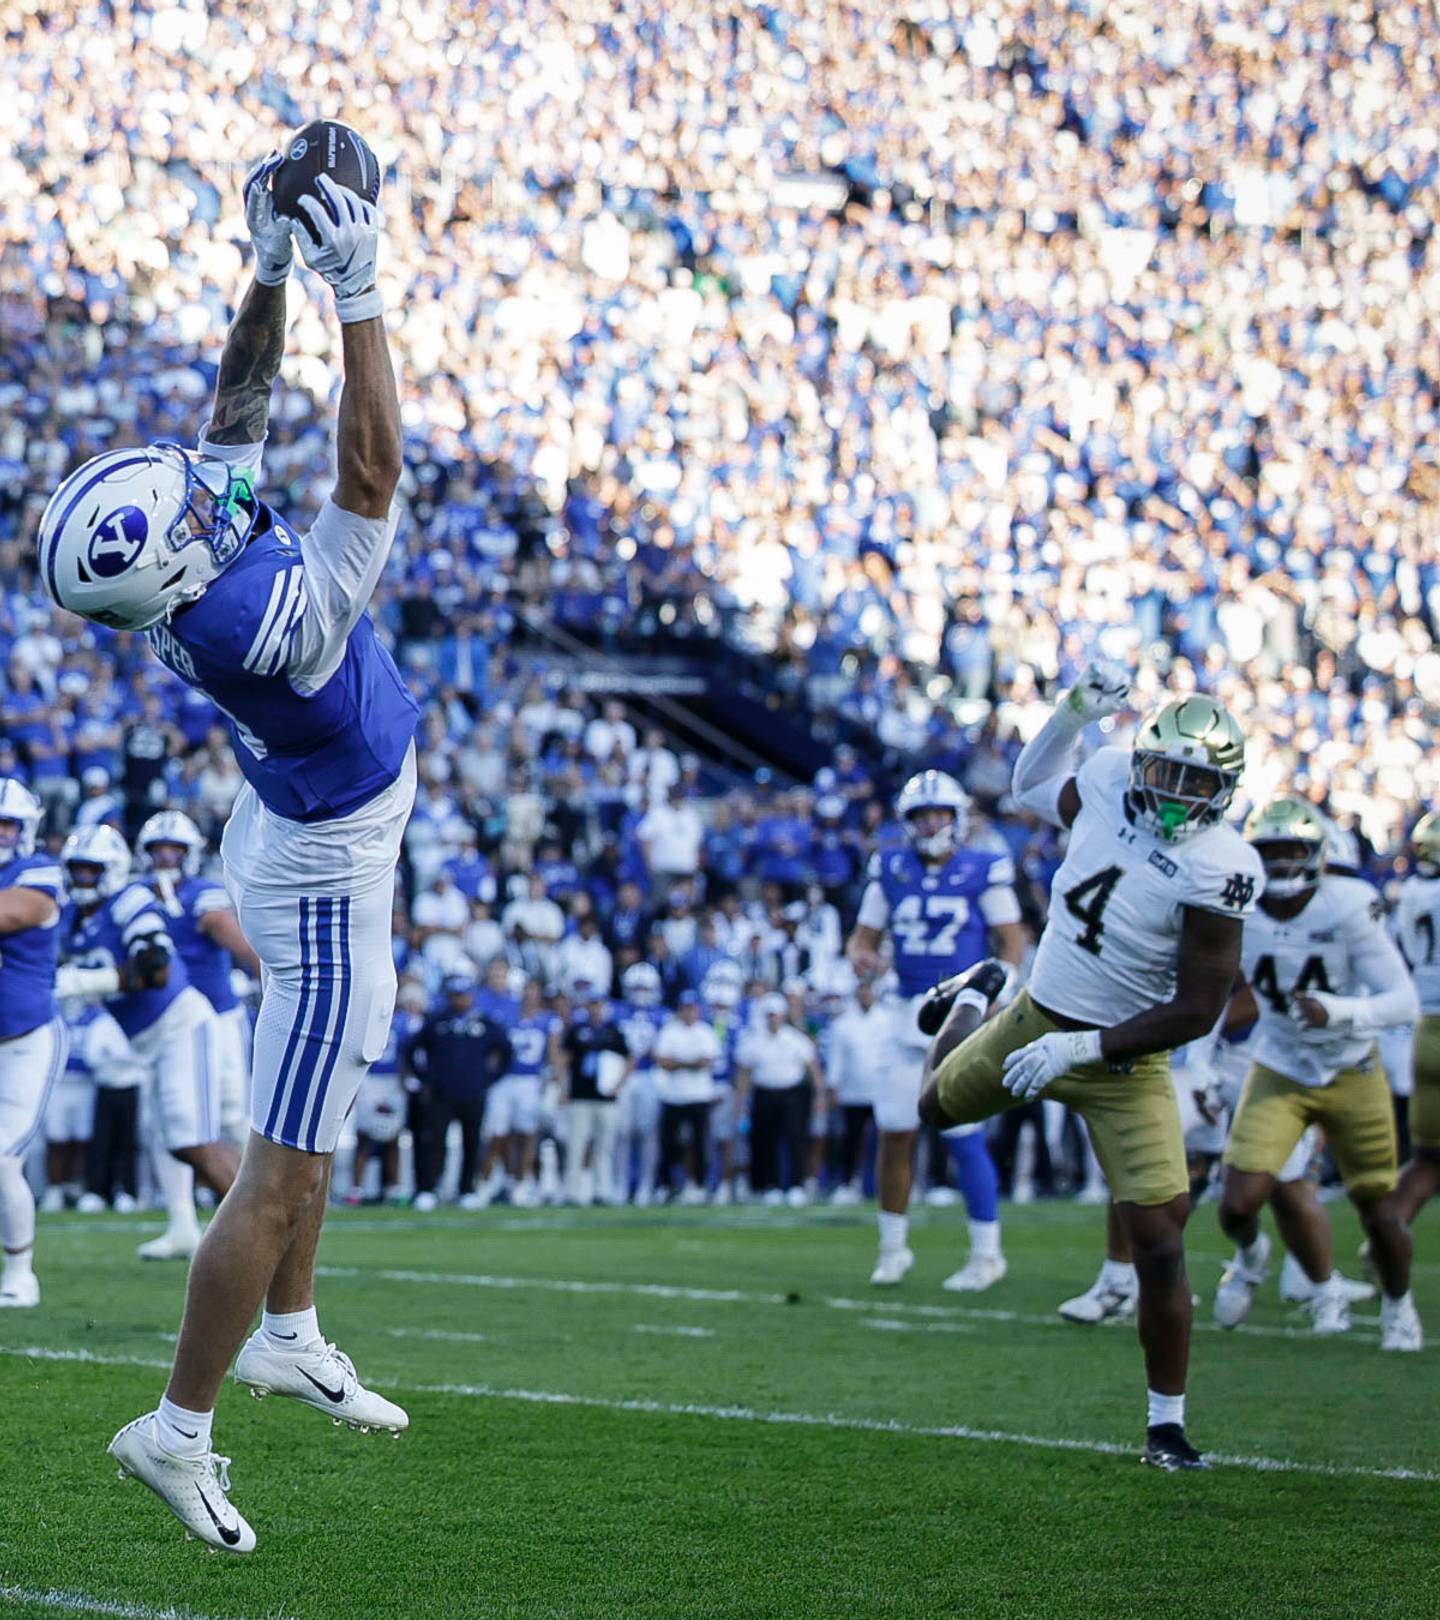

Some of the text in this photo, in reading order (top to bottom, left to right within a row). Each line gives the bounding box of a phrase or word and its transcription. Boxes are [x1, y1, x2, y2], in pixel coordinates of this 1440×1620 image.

[91, 512, 140, 562] Y
[893, 895, 970, 956] 47
[1064, 864, 1125, 957] 4
[1252, 954, 1338, 1016] 44
